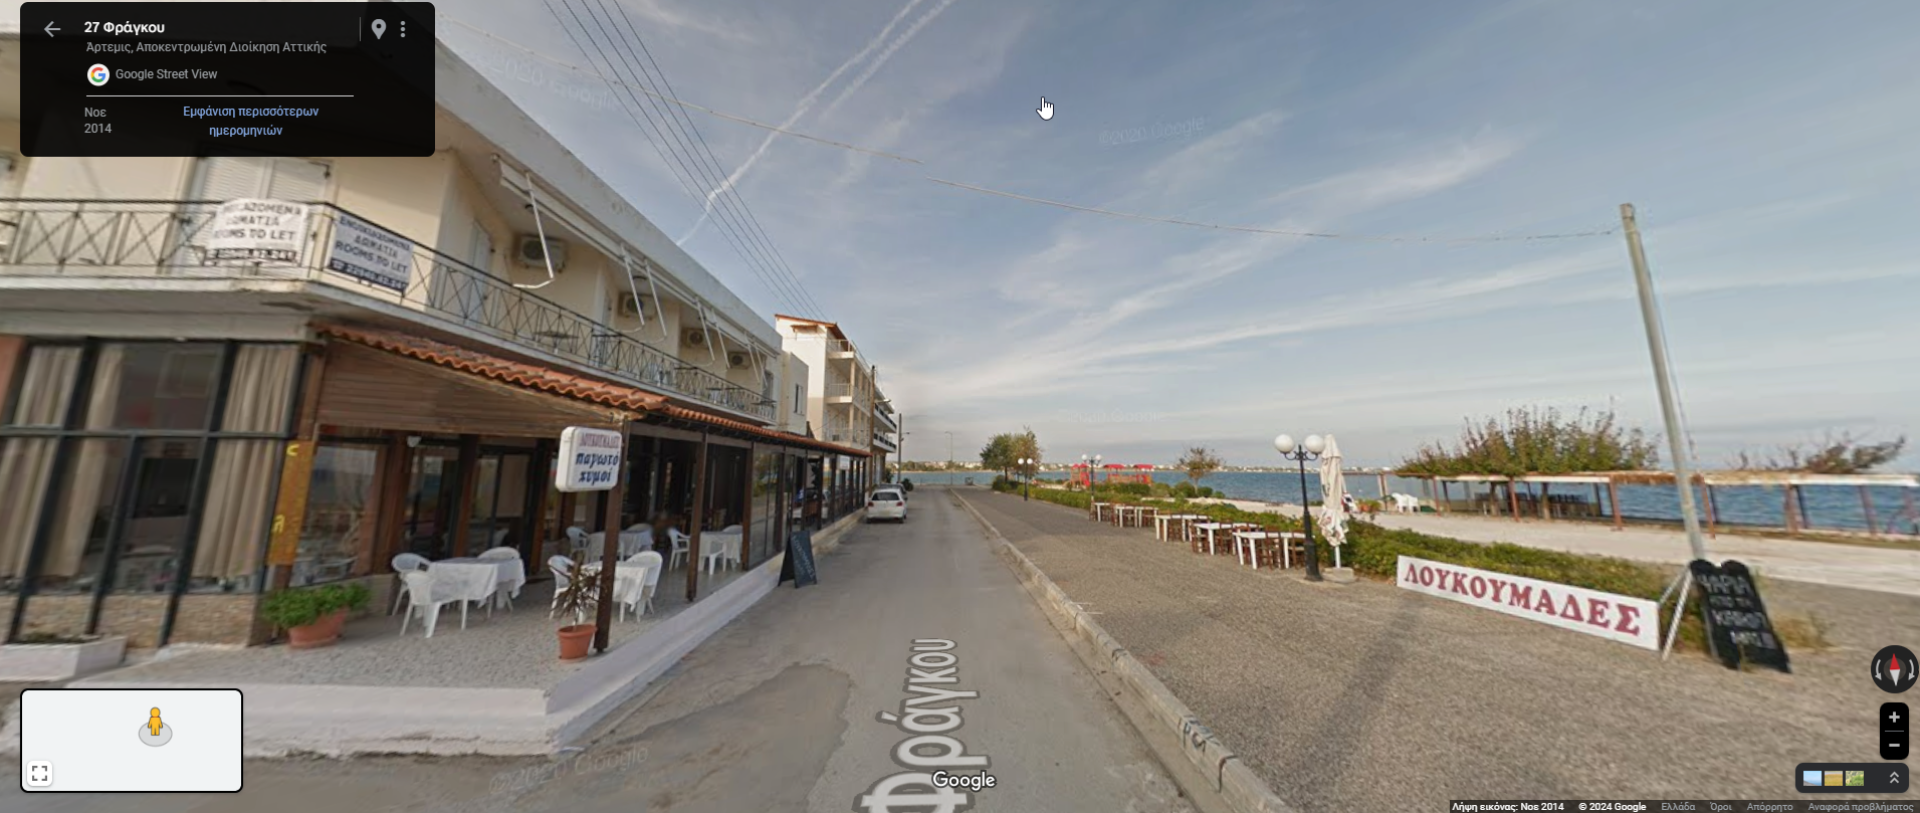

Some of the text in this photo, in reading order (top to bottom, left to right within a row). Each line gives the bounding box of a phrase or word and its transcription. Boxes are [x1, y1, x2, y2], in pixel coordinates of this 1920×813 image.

[270, 230, 297, 240] LET
[335, 240, 408, 274] ROOMS TO LET
[1404, 563, 1641, 637] ΛΟΥΚΟΥΜΑΔΕΣ
